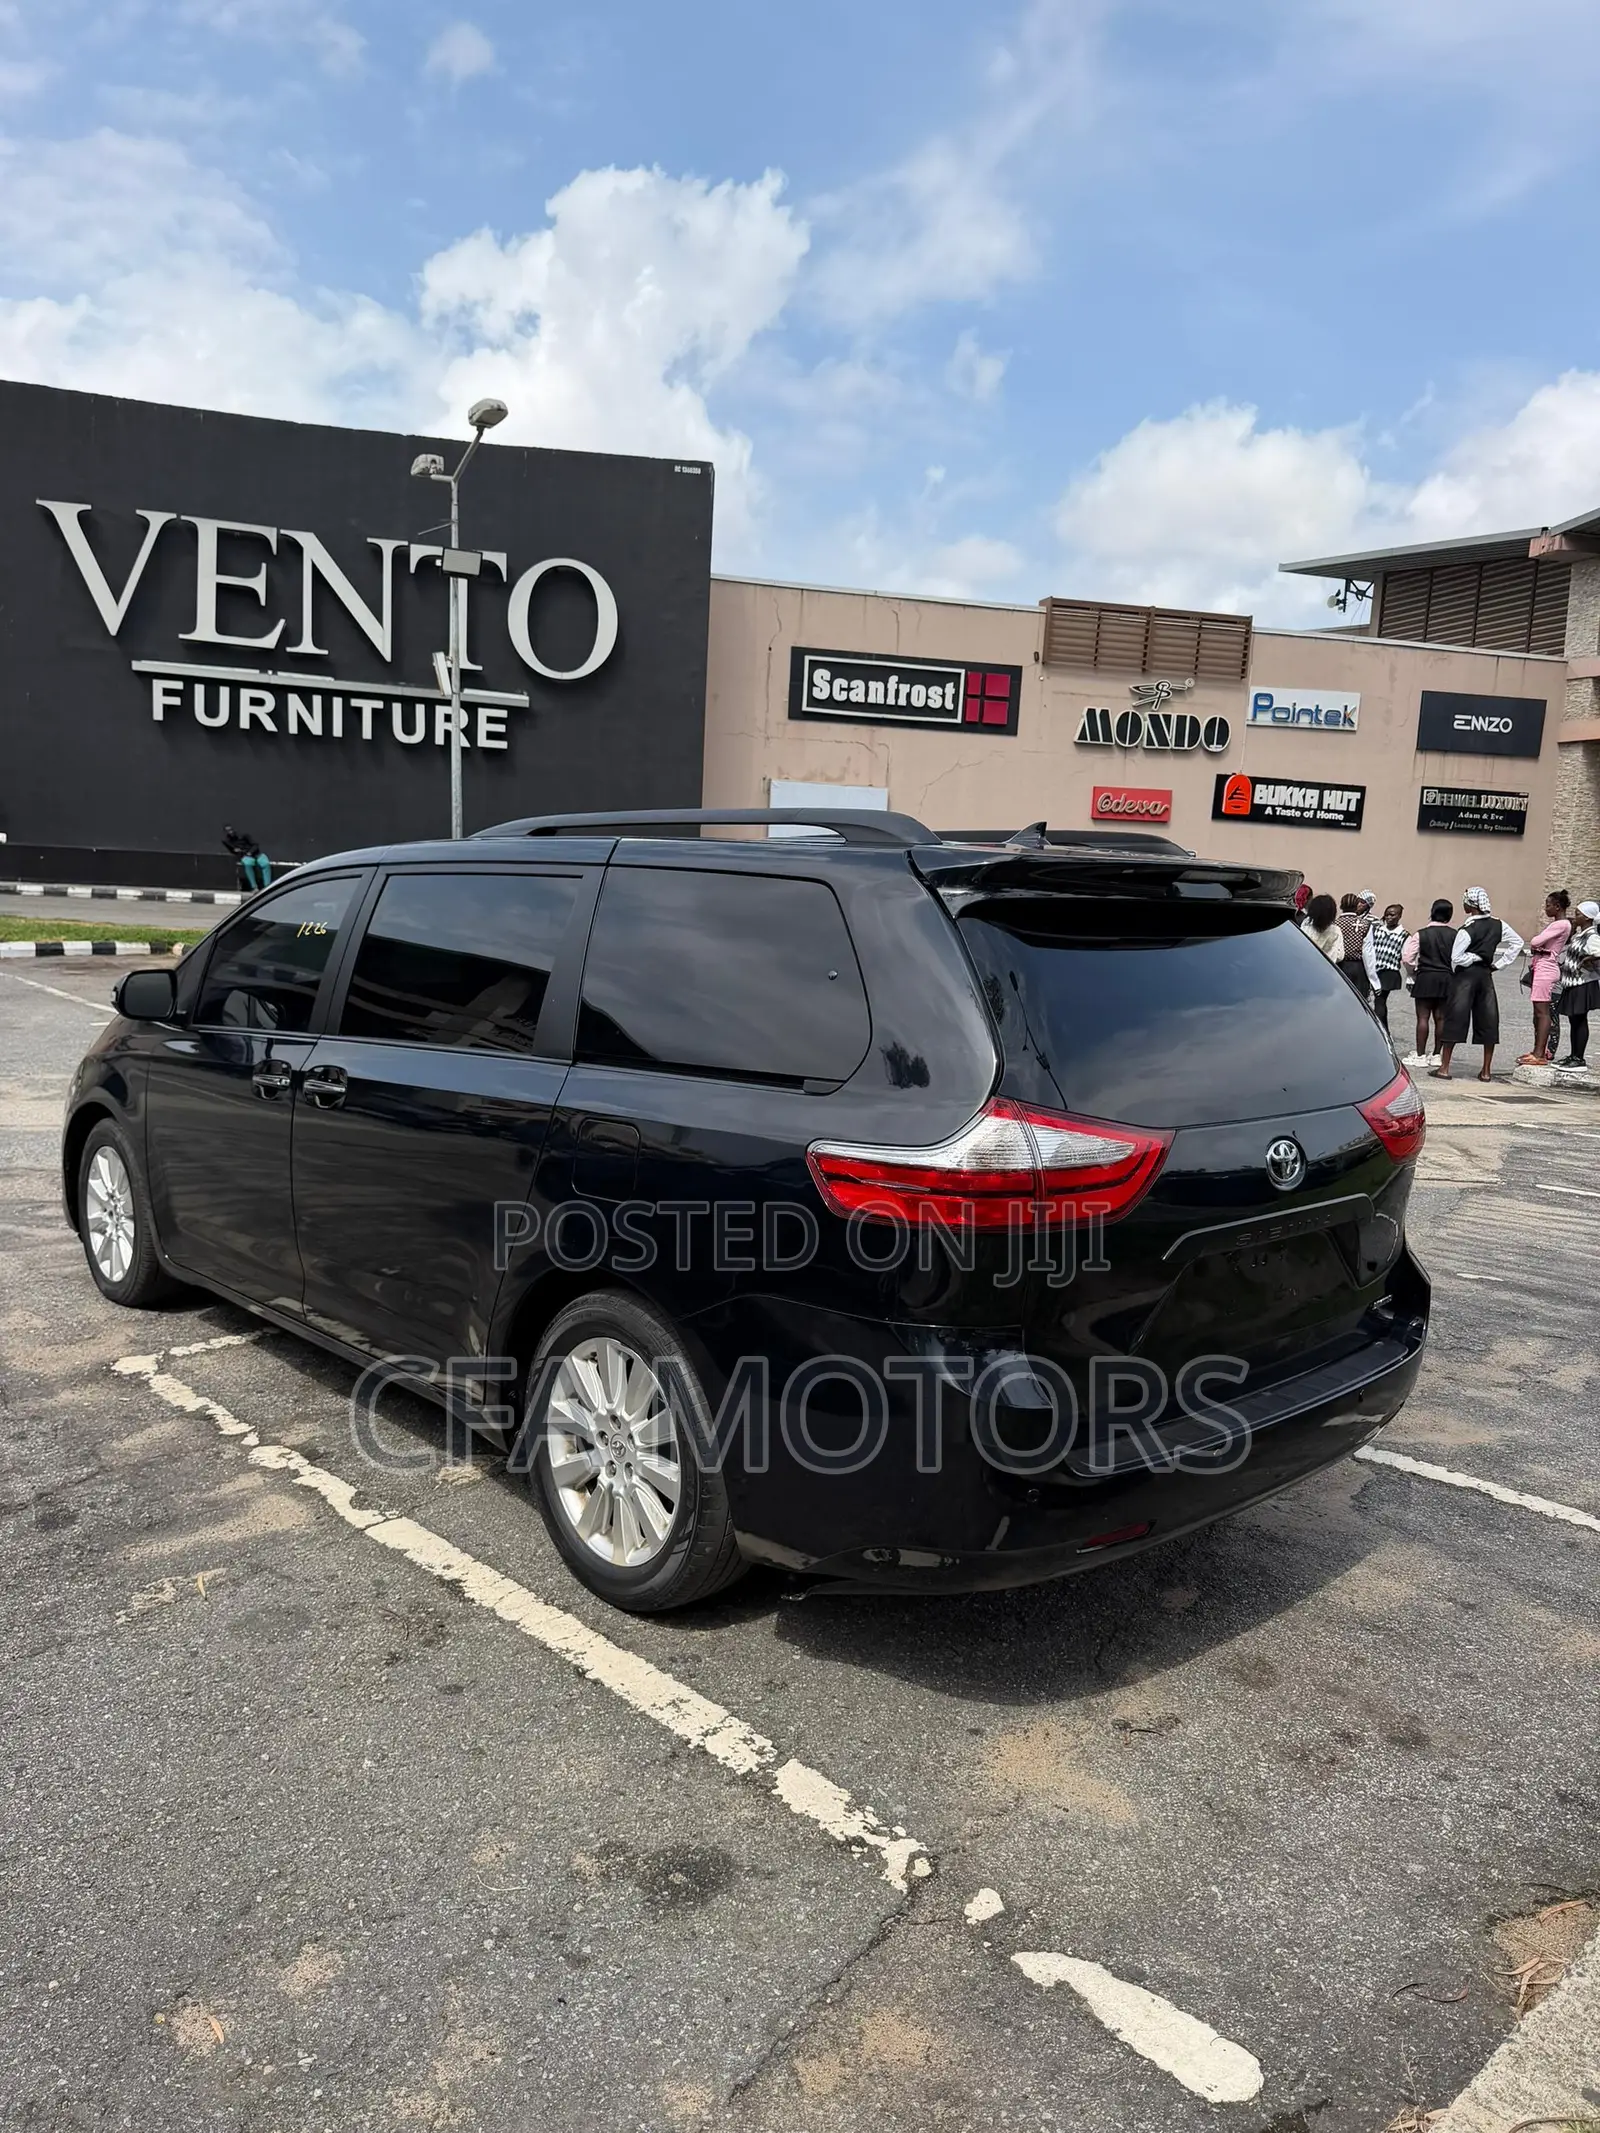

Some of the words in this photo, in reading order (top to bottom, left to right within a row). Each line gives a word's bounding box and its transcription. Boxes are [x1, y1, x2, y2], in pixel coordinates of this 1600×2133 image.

[36, 498, 618, 680] VENTO
[812, 668, 955, 710] Scanfrost
[152, 679, 508, 749] FURNITURE
[1074, 706, 1231, 752] MONDO
[1251, 692, 1356, 728] Pointek
[1253, 784, 1320, 809] BUKKA
[1322, 789, 1361, 812] HUT
[1264, 806, 1273, 815] A
[1275, 807, 1301, 818] Taste
[1303, 809, 1314, 818] of
[1316, 811, 1344, 821] Home
[1458, 812, 1480, 820] Adam
